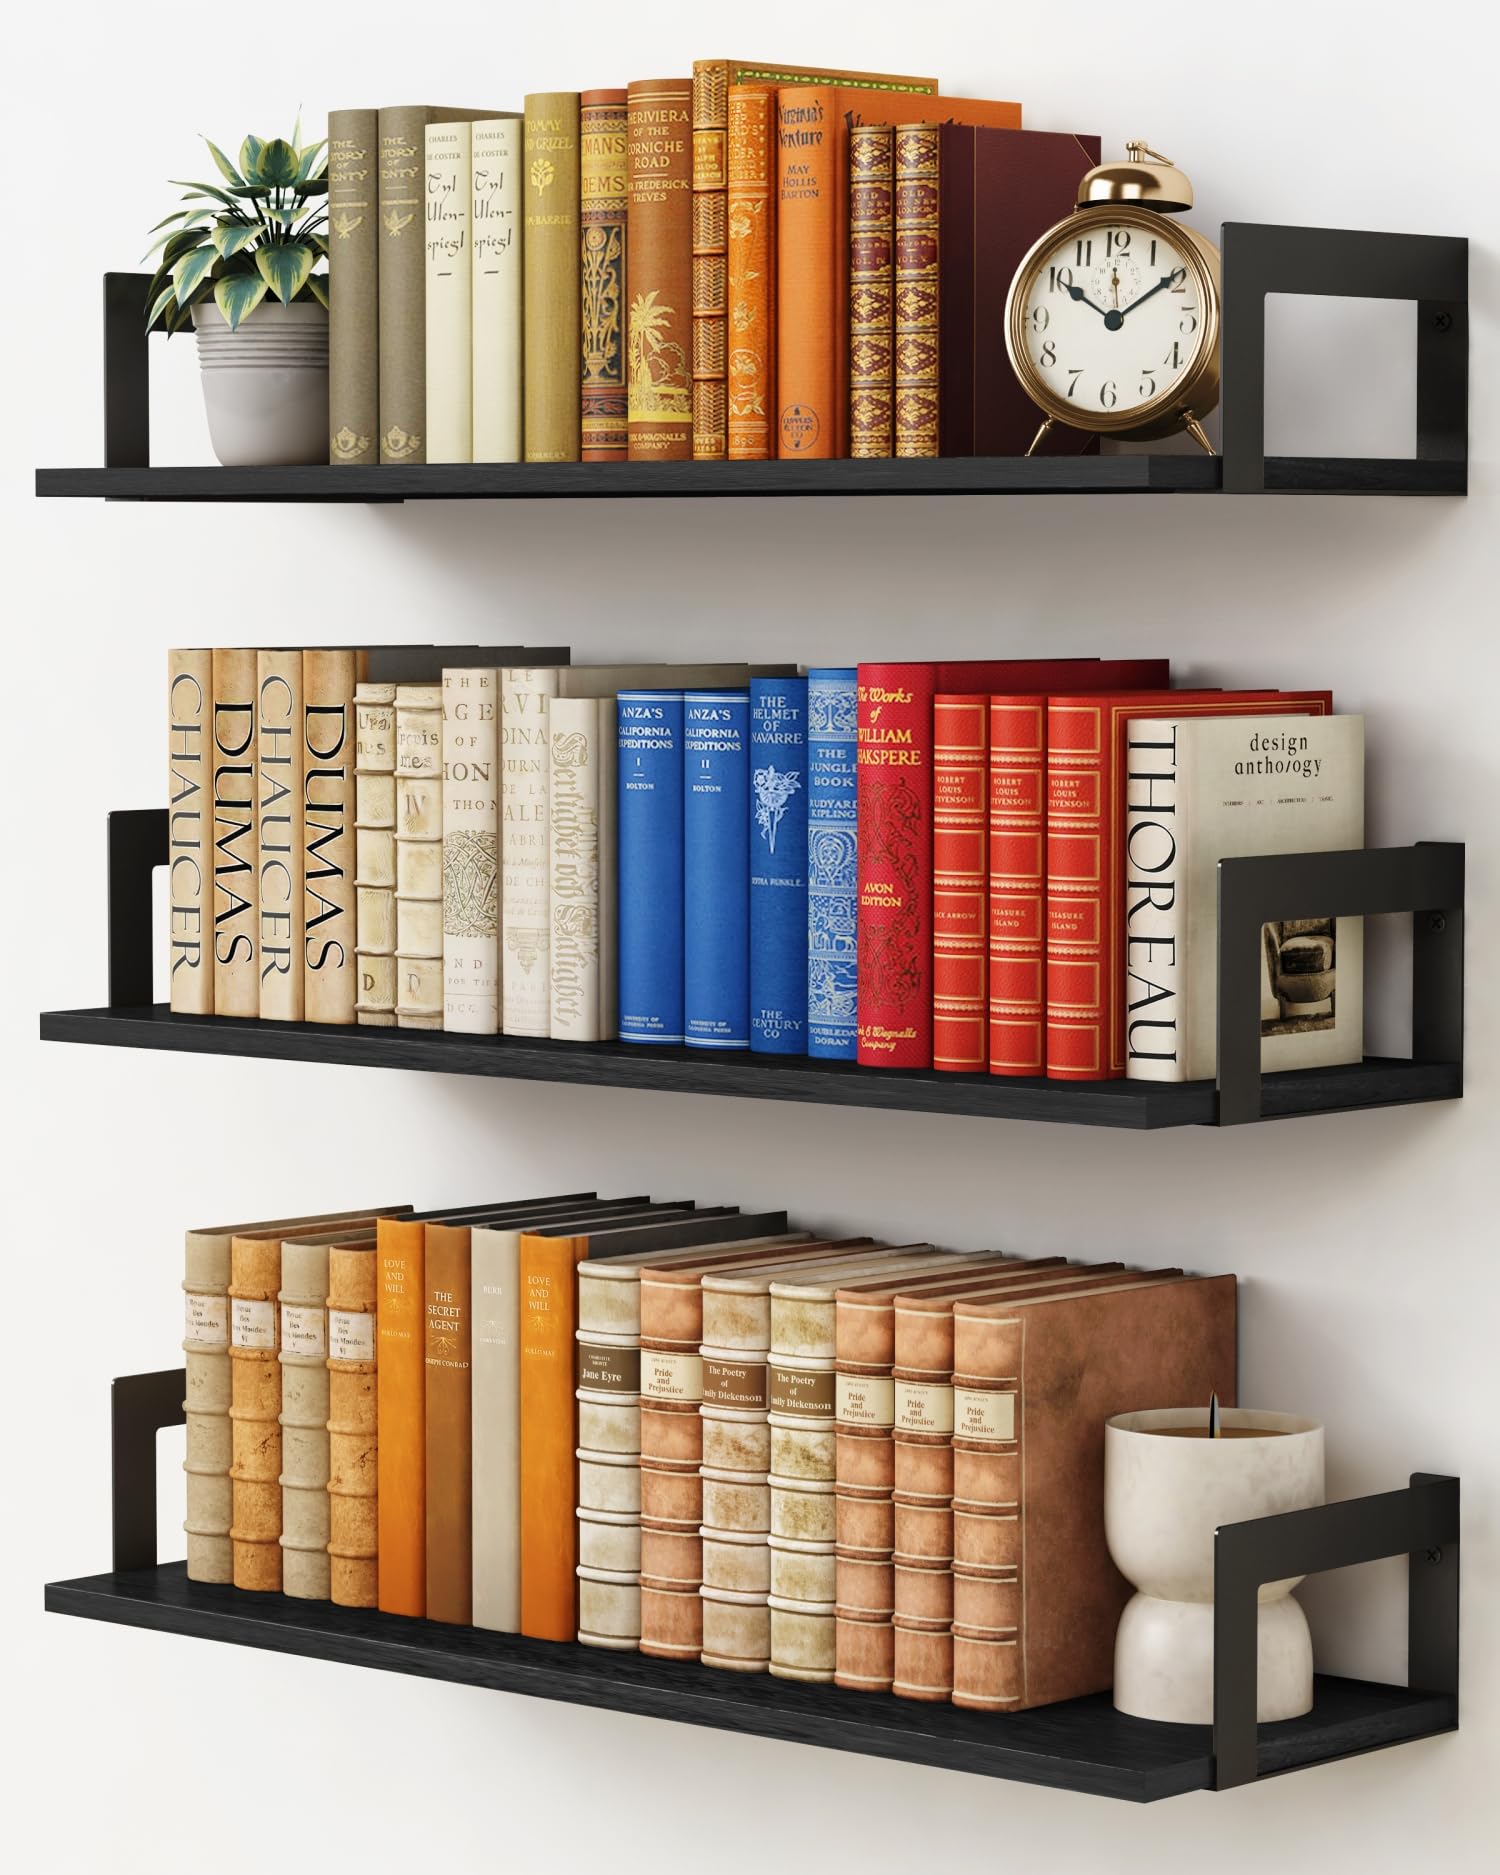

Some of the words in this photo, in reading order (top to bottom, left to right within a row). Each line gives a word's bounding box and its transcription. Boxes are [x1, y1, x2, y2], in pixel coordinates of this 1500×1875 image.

[637, 110, 689, 123] RIVIERA
[527, 119, 561, 132] TOMMY
[475, 133, 504, 141] CHARLES
[634, 128, 643, 137] OF
[648, 126, 669, 136] THE
[383, 137, 407, 146] THE
[779, 128, 823, 148] Venture
[332, 140, 356, 149] THE
[435, 152, 461, 160] COSTER
[481, 150, 508, 158] COSTER
[635, 156, 670, 169] ROAD
[787, 165, 810, 175] MAY
[475, 170, 503, 203] Tyl
[635, 180, 689, 190] FREDERICK
[783, 177, 816, 188] HOLLIS
[428, 172, 456, 206] Tyl
[782, 189, 819, 200] BARTON
[633, 192, 667, 203] TREVES
[856, 191, 878, 199] OLD
[1106, 231, 1131, 257] 12
[1076, 240, 1092, 266] 11
[1150, 240, 1156, 266] 1
[1049, 267, 1073, 293] 10
[1170, 267, 1187, 293] 2
[1033, 305, 1050, 333] 9
[1040, 340, 1056, 367] 8
[1163, 342, 1184, 369] 4
[1068, 369, 1084, 397] 7
[1139, 369, 1156, 397] 5
[1100, 380, 1117, 408] 6
[508, 669, 533, 681] LE
[444, 677, 489, 688] THE
[869, 687, 914, 704] Works
[760, 696, 787, 708] THE
[622, 707, 663, 719] ANZA'S
[688, 709, 731, 720] ANZA'S
[753, 709, 799, 720] HELMET
[870, 706, 882, 724] of
[763, 720, 780, 731] OF
[619, 726, 672, 737] CALIFORNIA
[685, 728, 740, 738] CALIFORNIA
[858, 728, 912, 744] WILLIAM
[455, 736, 477, 747] OF
[752, 733, 803, 744] NAVARRE
[1250, 732, 1309, 756] design
[817, 748, 847, 759] THE
[636, 757, 641, 766] I
[701, 759, 710, 768] II
[810, 763, 858, 773] JUNGLE
[814, 776, 854, 787] BOOK
[939, 785, 961, 794] LOUIS
[996, 787, 1019, 796] LOUIS
[1053, 789, 1077, 798] LOUIS
[504, 804, 545, 821] ALE
[811, 809, 857, 819] KIPLING
[171, 673, 202, 984] CHAUCER
[214, 701, 254, 965] DUMAS
[261, 675, 292, 988] CHAUCER
[305, 703, 346, 971] DUMAS
[864, 883, 894, 894] AVON
[1127, 725, 1178, 1064] THOREAU
[861, 895, 902, 907] EDITION
[363, 974, 375, 991] D
[408, 974, 421, 993] D
[761, 1010, 783, 1020] THE
[752, 1018, 802, 1029] CENTURY
[764, 1029, 780, 1039] CO
[815, 1037, 849, 1046] DORAN
[861, 1039, 897, 1052] Company
[384, 1259, 406, 1270] LOVE
[385, 1271, 404, 1281] AND
[528, 1275, 550, 1286] LOVE
[385, 1284, 405, 1294] WILL
[529, 1288, 548, 1298] AND
[434, 1291, 453, 1302] THE
[428, 1304, 461, 1318] SECRET
[528, 1301, 550, 1311] WILL
[429, 1320, 460, 1331] AGENT
[442, 1360, 469, 1368] CONRAD
[582, 1368, 599, 1379] Jane
[601, 1370, 622, 1383] Eyre
[654, 1368, 673, 1378] Pride
[709, 1366, 721, 1375] The
[722, 1367, 747, 1379] Poetry
[657, 1377, 670, 1385] and
[720, 1380, 728, 1388] of
[777, 1373, 789, 1383] The
[791, 1375, 816, 1386] Poetry
[703, 1389, 716, 1400] mily
[718, 1391, 762, 1402] Dickenson
[848, 1392, 866, 1402] Pride
[771, 1395, 786, 1407] mily
[787, 1398, 832, 1410] Dickenson
[850, 1401, 863, 1409] and
[907, 1400, 925, 1409] Pride
[909, 1409, 922, 1417] and
[966, 1407, 985, 1416] Pride
[969, 1416, 982, 1424] and
